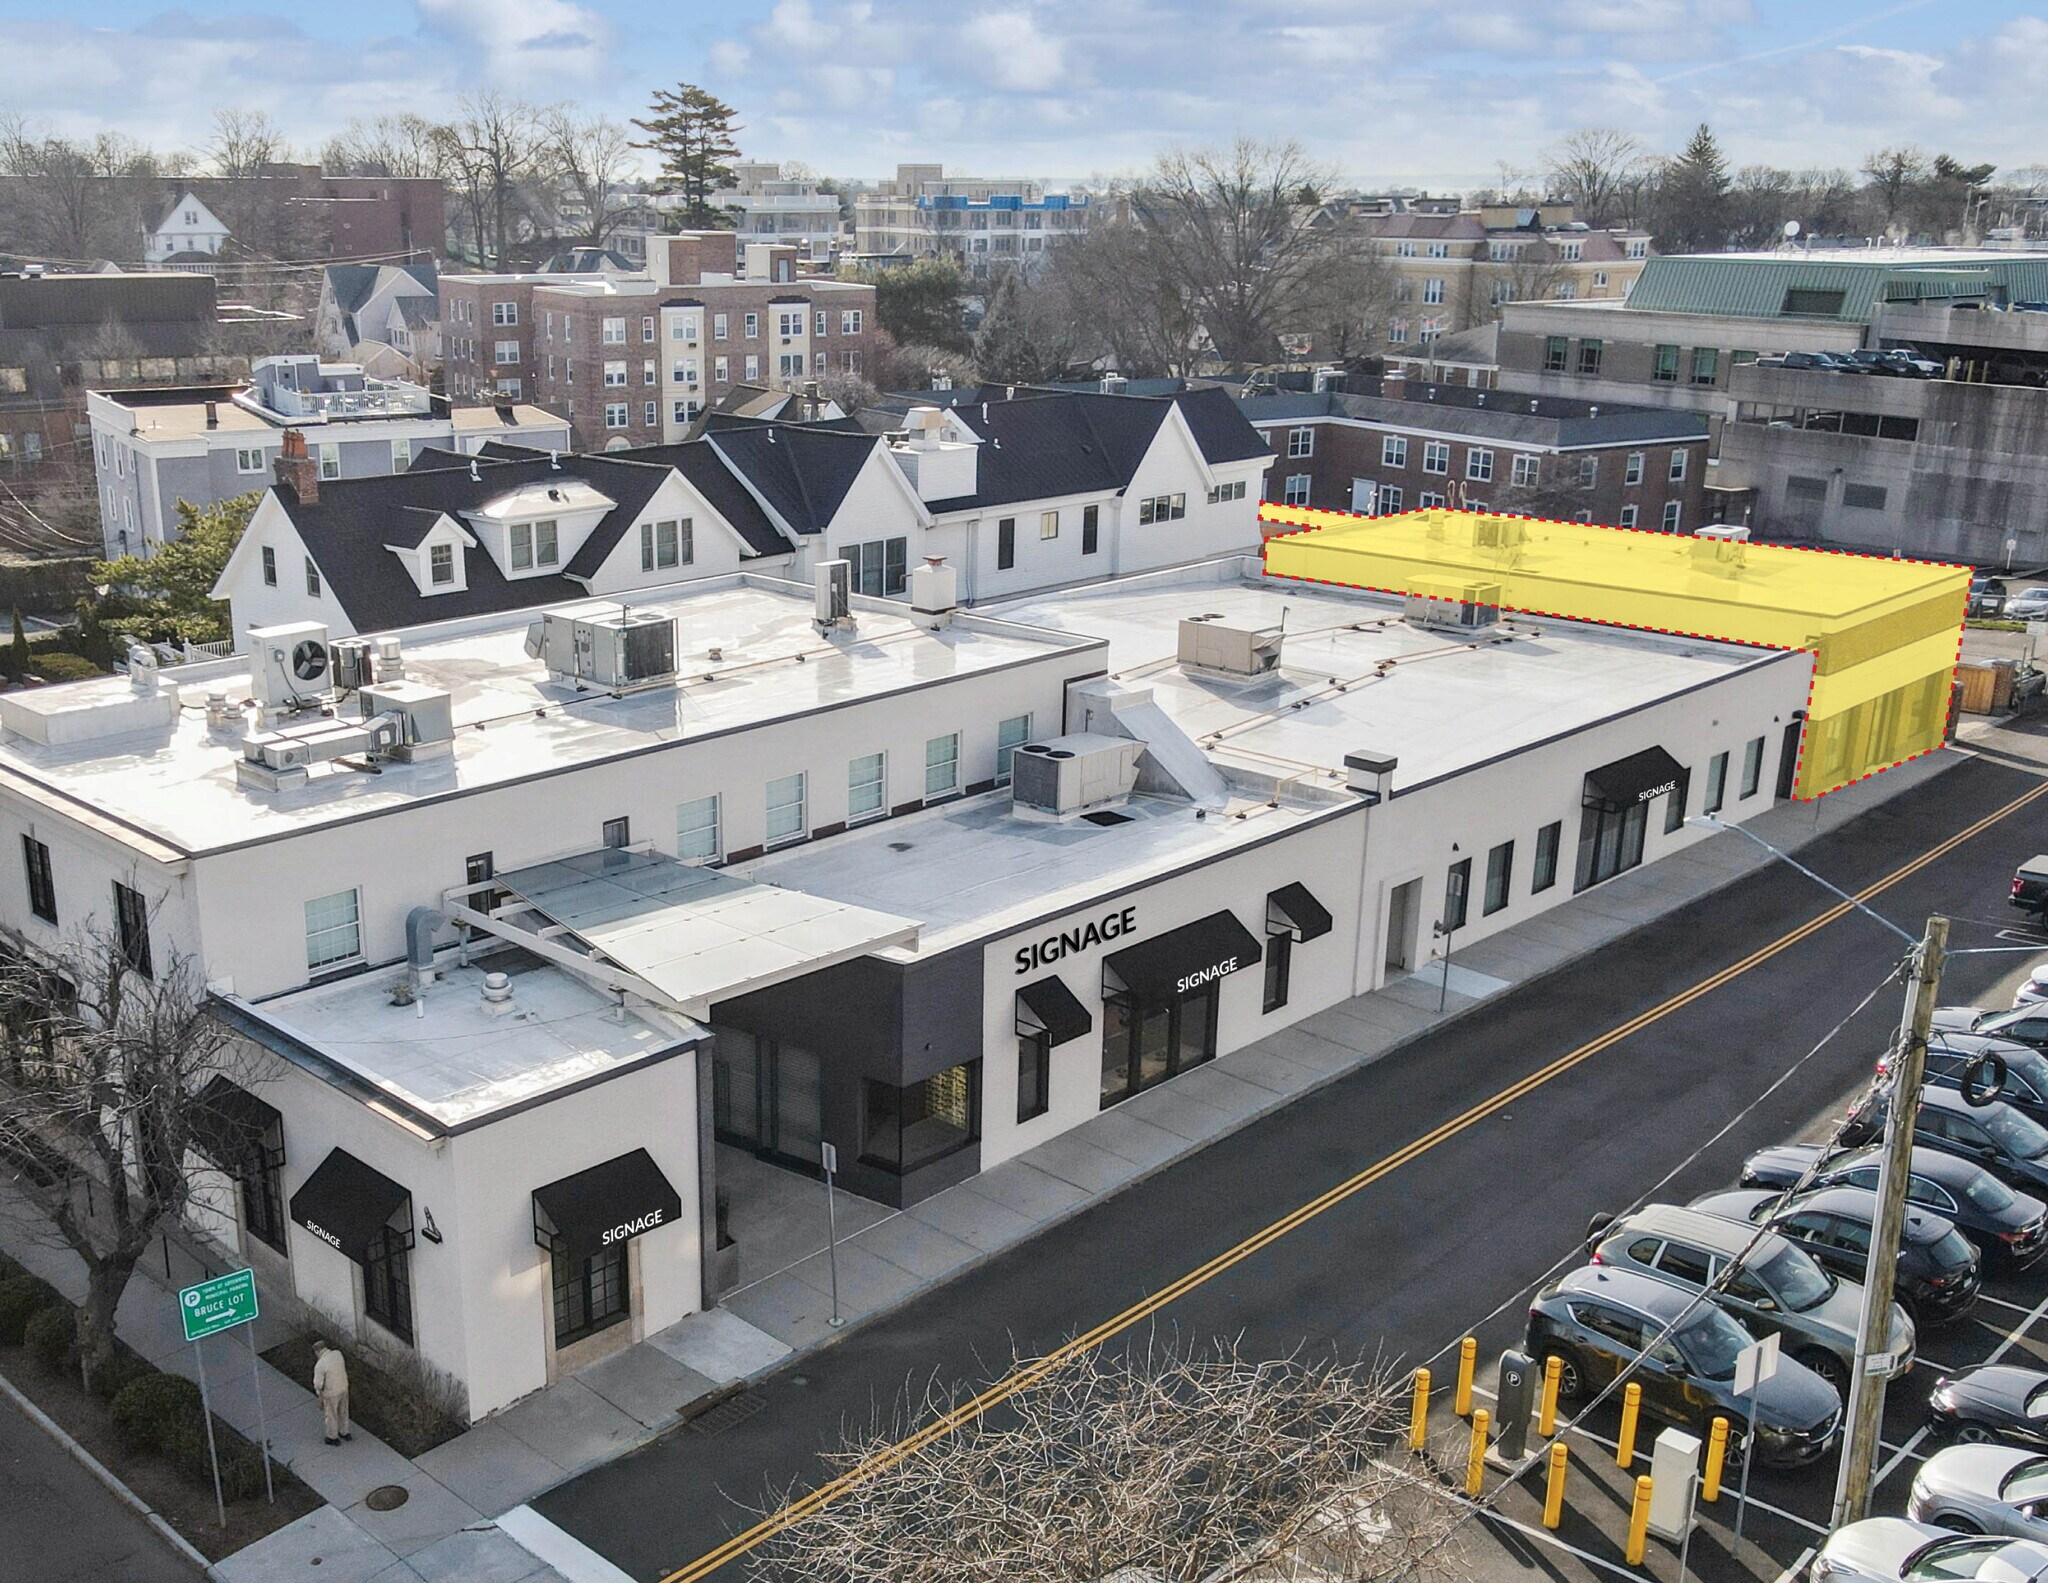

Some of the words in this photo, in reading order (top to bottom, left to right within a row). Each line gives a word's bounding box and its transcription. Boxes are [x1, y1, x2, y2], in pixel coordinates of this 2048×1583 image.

[1639, 780, 1676, 801] SIGNAGE
[1015, 906, 1136, 975] SIGNAGE
[1177, 957, 1238, 992] SIGNAGE
[306, 1220, 341, 1249] SIGNAGE
[602, 1208, 663, 1245] SIGNAGE
[194, 1299, 224, 1317] BRUCE
[228, 1292, 245, 1306] LOT
[1510, 1373, 1518, 1383] P
